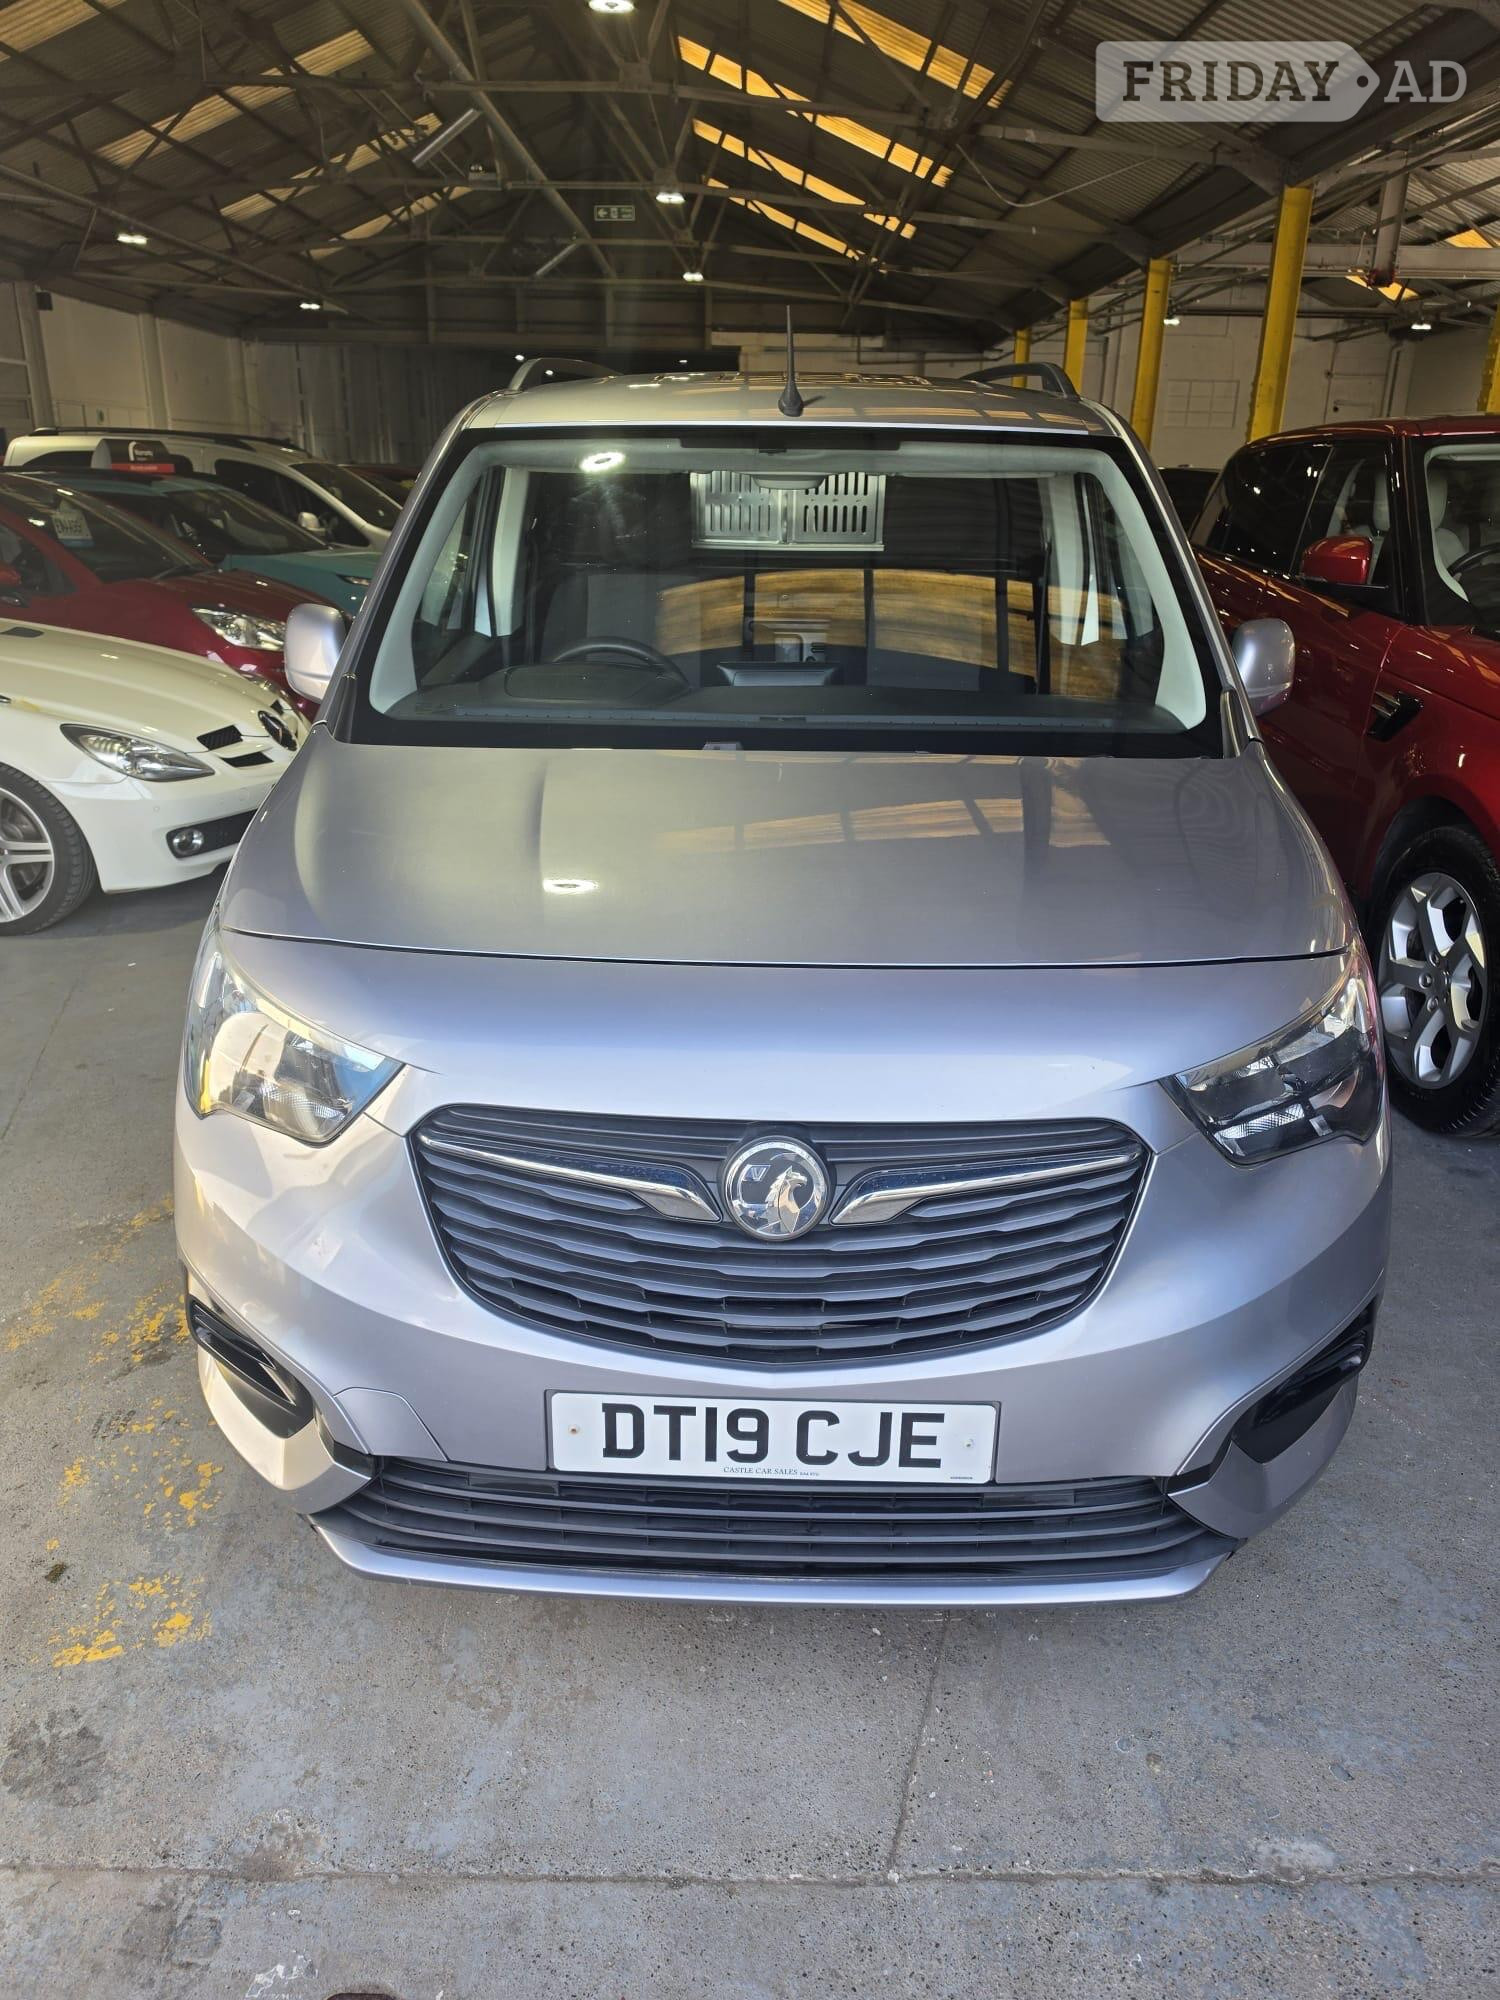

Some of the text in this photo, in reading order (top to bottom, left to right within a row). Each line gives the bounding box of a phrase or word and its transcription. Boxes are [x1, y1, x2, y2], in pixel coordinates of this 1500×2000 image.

[602, 1402, 945, 1469] DT19 CJE
[723, 1466, 753, 1474] CASTLE
[755, 1467, 773, 1475] CAR
[774, 1468, 798, 1476] SALES
